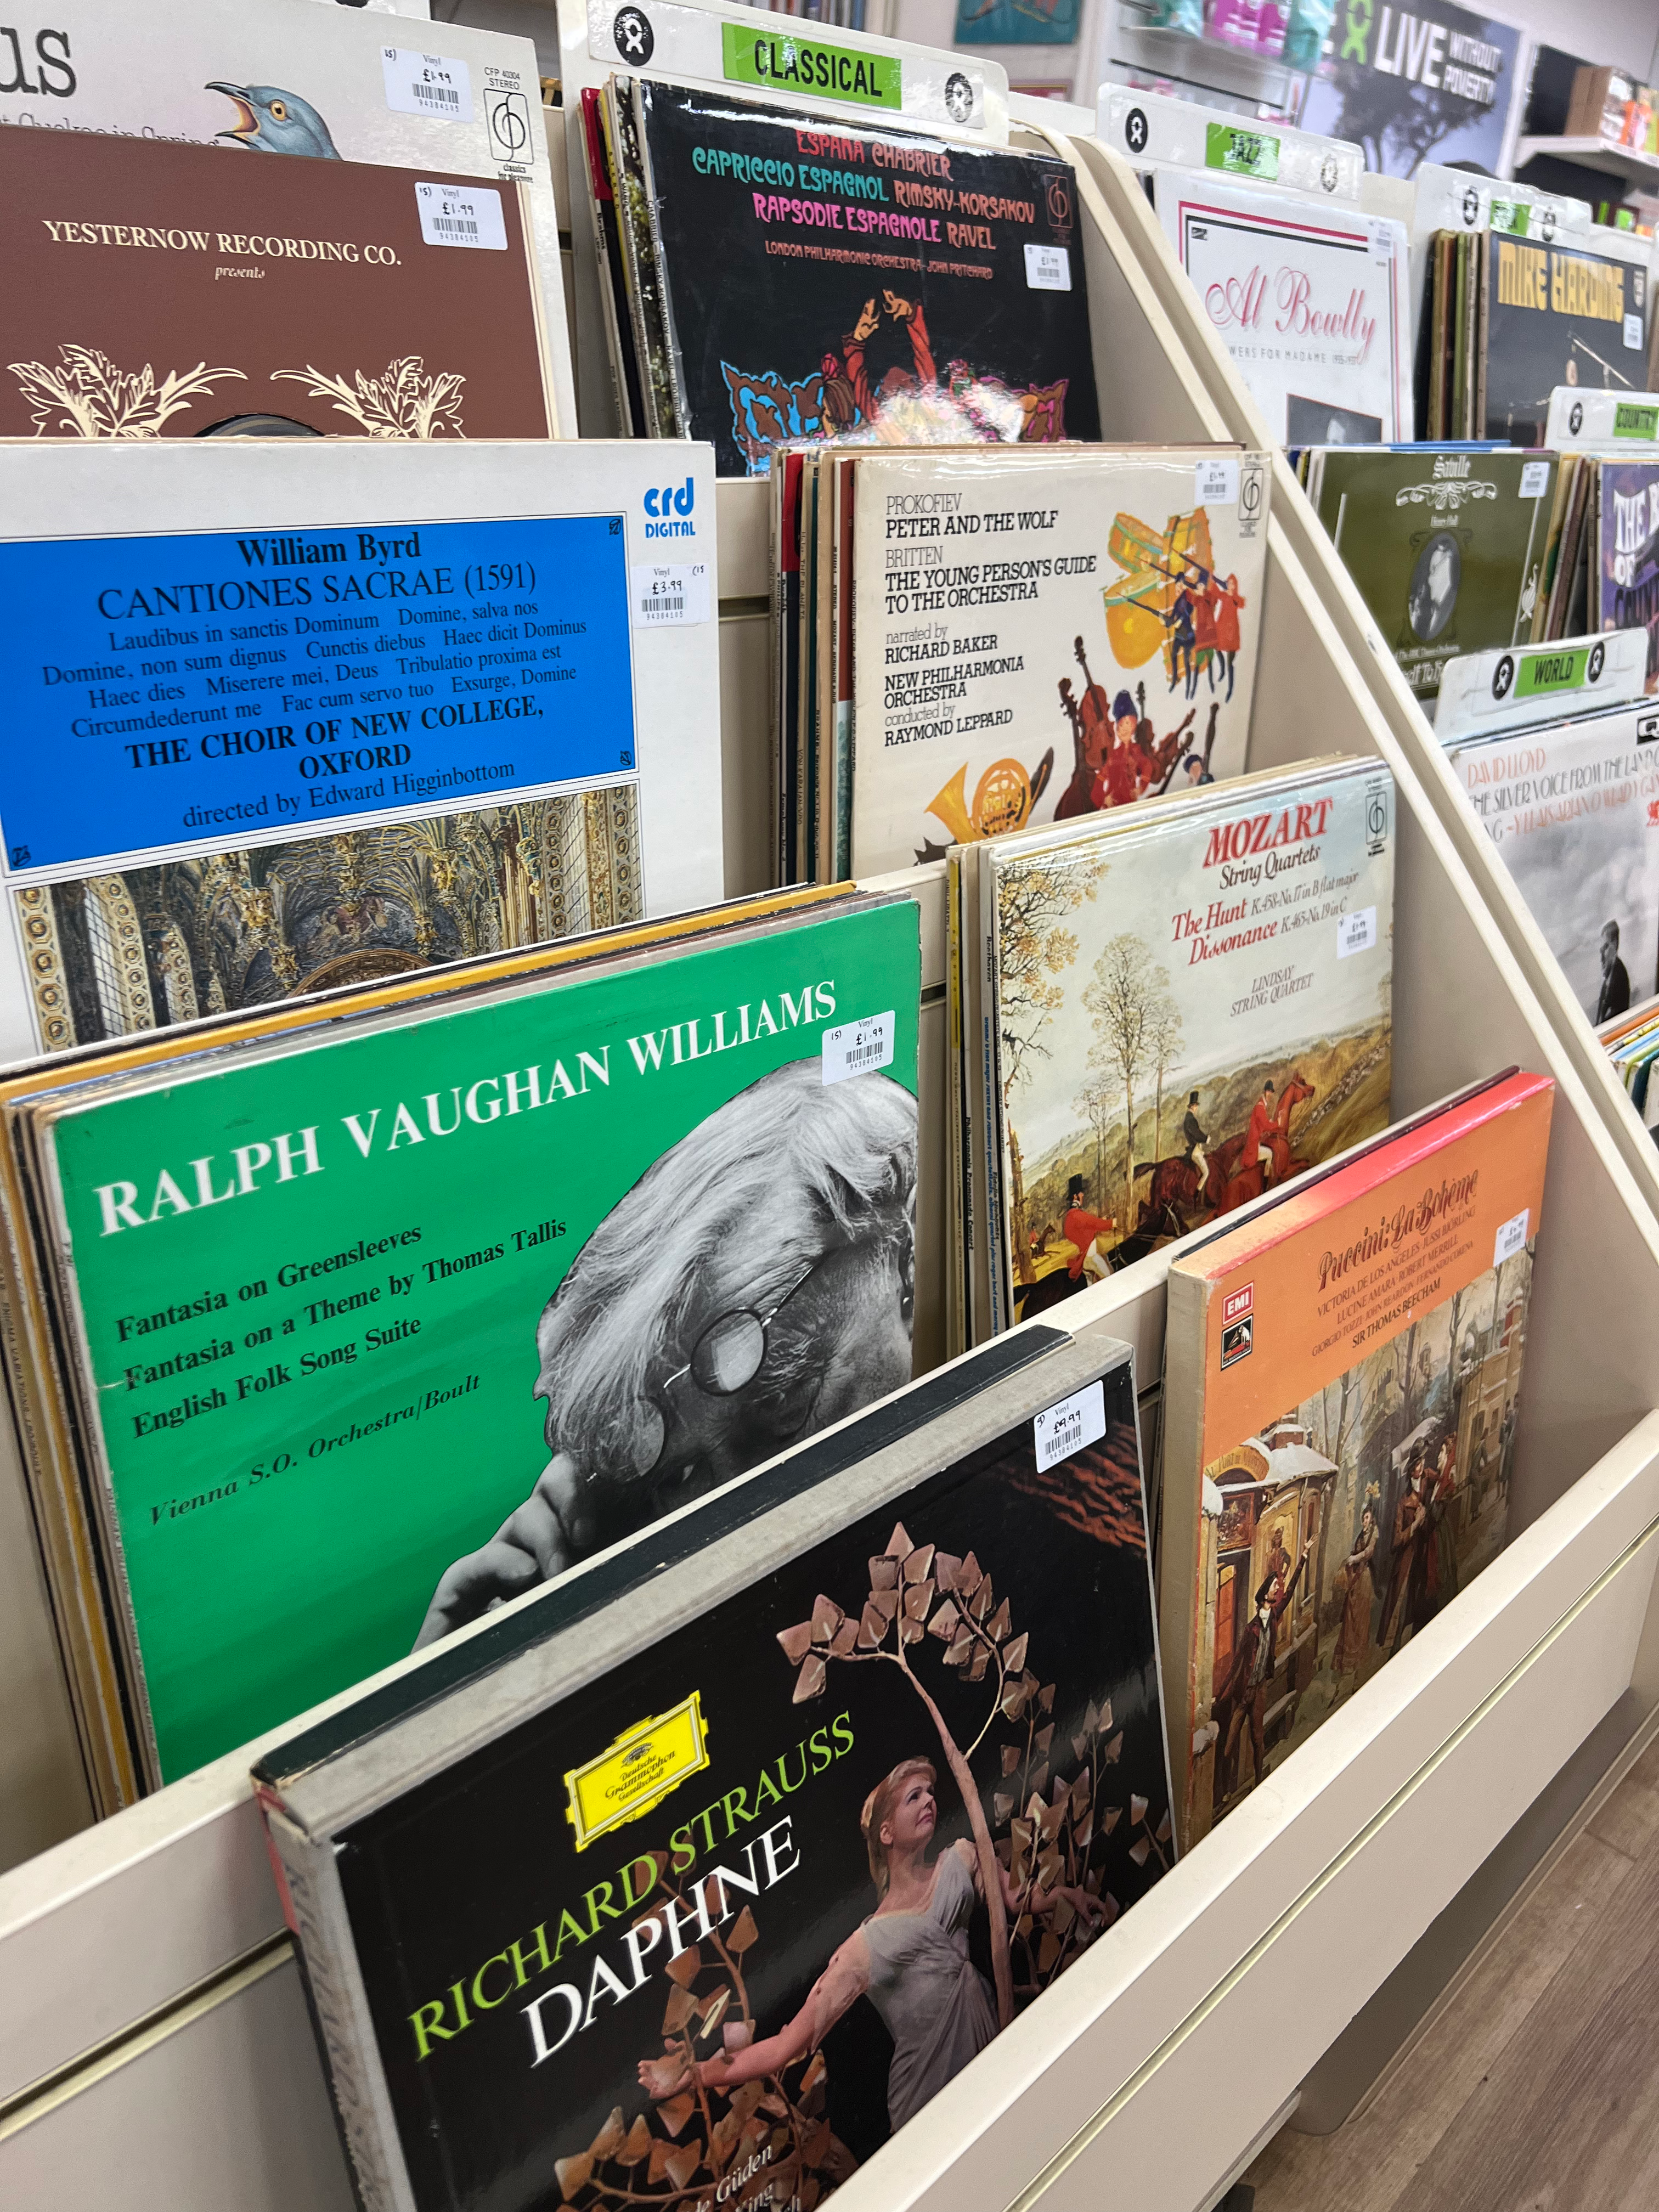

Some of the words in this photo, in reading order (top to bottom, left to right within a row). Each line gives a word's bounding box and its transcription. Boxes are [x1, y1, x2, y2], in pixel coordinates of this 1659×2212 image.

[423, 54, 441, 66] Vinyl
[1374, 6, 1448, 88] LIVE
[422, 69, 452, 83] £1.99
[484, 67, 499, 76] CFP
[489, 78, 519, 89] STEREO
[755, 38, 882, 97] CLASSICAL
[872, 143, 953, 181] CHABRIER
[442, 189, 460, 199] Vinyl
[692, 146, 795, 187] CAPRICCIO
[799, 166, 889, 202] ESPAGNOL
[893, 180, 1035, 224] RIMSKY-KORSAKOV
[442, 202, 474, 215] £1.99
[752, 193, 841, 228] RAPSODIE
[846, 207, 943, 244] ESPAGNOLE
[946, 222, 996, 250] RAVEL
[42, 220, 210, 251] YESTERNOW
[216, 233, 360, 263] RECORDING
[364, 244, 402, 266] CO.
[765, 240, 803, 257] LONDON
[215, 266, 266, 280] presents
[1498, 241, 1547, 311] MIKE
[1206, 265, 1267, 328] Al
[1274, 266, 1375, 364] Bowlly
[644, 477, 694, 517] crd
[886, 493, 962, 515] PROKOFIEV
[645, 521, 696, 538] DIGITAL
[886, 517, 939, 539] PETER
[944, 515, 980, 535] AND
[984, 512, 1014, 533] THE
[1018, 510, 1058, 530] WOLF
[1613, 488, 1646, 552] THE
[237, 537, 347, 567] William
[358, 532, 421, 566] Byrd
[886, 545, 943, 568] BRITTEN
[652, 580, 682, 595] £3.99
[654, 568, 670, 577] Vinyl
[886, 571, 919, 591] THE
[924, 565, 979, 589] YOUNG
[982, 560, 1051, 583] PERSON'S
[1054, 556, 1096, 575] GUIDE
[1614, 554, 1635, 588] OF
[98, 577, 312, 620] CANTIONES
[324, 567, 454, 604] SACRAE
[464, 561, 535, 600] (1591)
[886, 595, 909, 614] TO
[912, 591, 944, 612] THE
[948, 582, 1038, 607] ORCHESTRA
[109, 628, 199, 651] Laudibus
[207, 623, 224, 642] in
[231, 619, 288, 641] sanctis
[295, 613, 379, 635] Dominum
[399, 606, 466, 627] Domine,
[472, 604, 508, 620] salva
[514, 602, 538, 617] nos
[886, 623, 932, 644] narrated
[934, 623, 948, 639] by
[43, 662, 133, 686] Domine,
[141, 659, 177, 676] non
[184, 654, 222, 672] sum
[229, 647, 287, 670] dignus
[306, 638, 369, 659] Cunctis
[375, 634, 426, 652] diebus
[443, 627, 484, 646] Haec
[488, 625, 518, 642] dicit
[524, 619, 587, 639] Dominus
[885, 642, 950, 664] RICHARD
[953, 635, 997, 655] BAKER
[885, 671, 919, 691] NEW
[922, 656, 1024, 686] PHILHARMONIA
[1534, 656, 1573, 685] WORLD
[885, 682, 967, 709] ORCHESTRA
[885, 704, 940, 726] conducted
[943, 702, 956, 719] by
[125, 738, 190, 769] THE
[201, 725, 298, 759] CHOIR
[306, 719, 342, 745] OF
[352, 711, 411, 740] NEW
[421, 695, 544, 730] COLLEGE,
[885, 720, 953, 746] RAYMOND
[957, 709, 1013, 733] LEPPARD
[299, 744, 411, 779] OXFORD
[183, 795, 268, 828] directed
[276, 793, 300, 816] by
[309, 778, 384, 808] Edward
[393, 762, 515, 797] Higginbottom
[1203, 796, 1333, 869] MOZART
[1220, 860, 1261, 890] String
[1263, 843, 1320, 879] Quartets
[1172, 909, 1202, 942] The
[1204, 898, 1246, 931] Hunt
[1312, 879, 1319, 895] B
[1318, 876, 1334, 899] flat
[1336, 868, 1358, 890] major
[1188, 921, 1278, 966] Dissonance
[1330, 900, 1338, 917] in
[1340, 896, 1347, 913] C
[1231, 992, 1268, 1017] STRING
[1271, 972, 1313, 1003] QUARTET
[1251, 964, 1294, 994] LINDSAY
[856, 1027, 882, 1046] £1.99
[859, 1018, 873, 1028] Vinyl
[93, 1125, 325, 1237] RALPH
[341, 1046, 610, 1158] VAUGHAN
[627, 980, 836, 1076] WILLIAMS
[1391, 1205, 1414, 1249] La
[116, 1293, 227, 1342] Fantasia
[239, 1280, 268, 1301] on
[278, 1227, 422, 1288] Greensleeves
[1318, 1286, 1355, 1317] VICTORIA
[1357, 1277, 1368, 1293] DE
[1370, 1267, 1384, 1284] LOS
[1385, 1242, 1420, 1273] ANGELES
[123, 1339, 235, 1391] Fantasia
[245, 1327, 273, 1348] on
[283, 1319, 296, 1336] a
[304, 1287, 380, 1327] Theme
[389, 1274, 414, 1297] by
[422, 1243, 505, 1286] Thomas
[511, 1220, 566, 1253] Tallis
[1227, 1291, 1249, 1316] EMI
[1352, 1330, 1365, 1348] SIR
[1366, 1304, 1401, 1338] THOMAS
[1402, 1277, 1441, 1313] BEECHAM
[131, 1388, 227, 1439] English
[235, 1362, 292, 1402] Folk
[301, 1343, 357, 1378] Song
[366, 1318, 421, 1352] Suite
[1054, 1403, 1069, 1415] Vinyl
[150, 1480, 239, 1526] Vienna
[249, 1454, 297, 1485] S.O.
[308, 1374, 481, 1459] Orchestra/Boult
[605, 1751, 675, 1800] Grammophon
[618, 1768, 664, 1802] Gesellschaft
[620, 1755, 657, 1781] Deutsche
[407, 1854, 658, 2062] RICHARD
[669, 1711, 855, 1874] STRAUSS
[520, 1815, 801, 2069] DAPHNE
[717, 2145, 773, 2202] Güden
